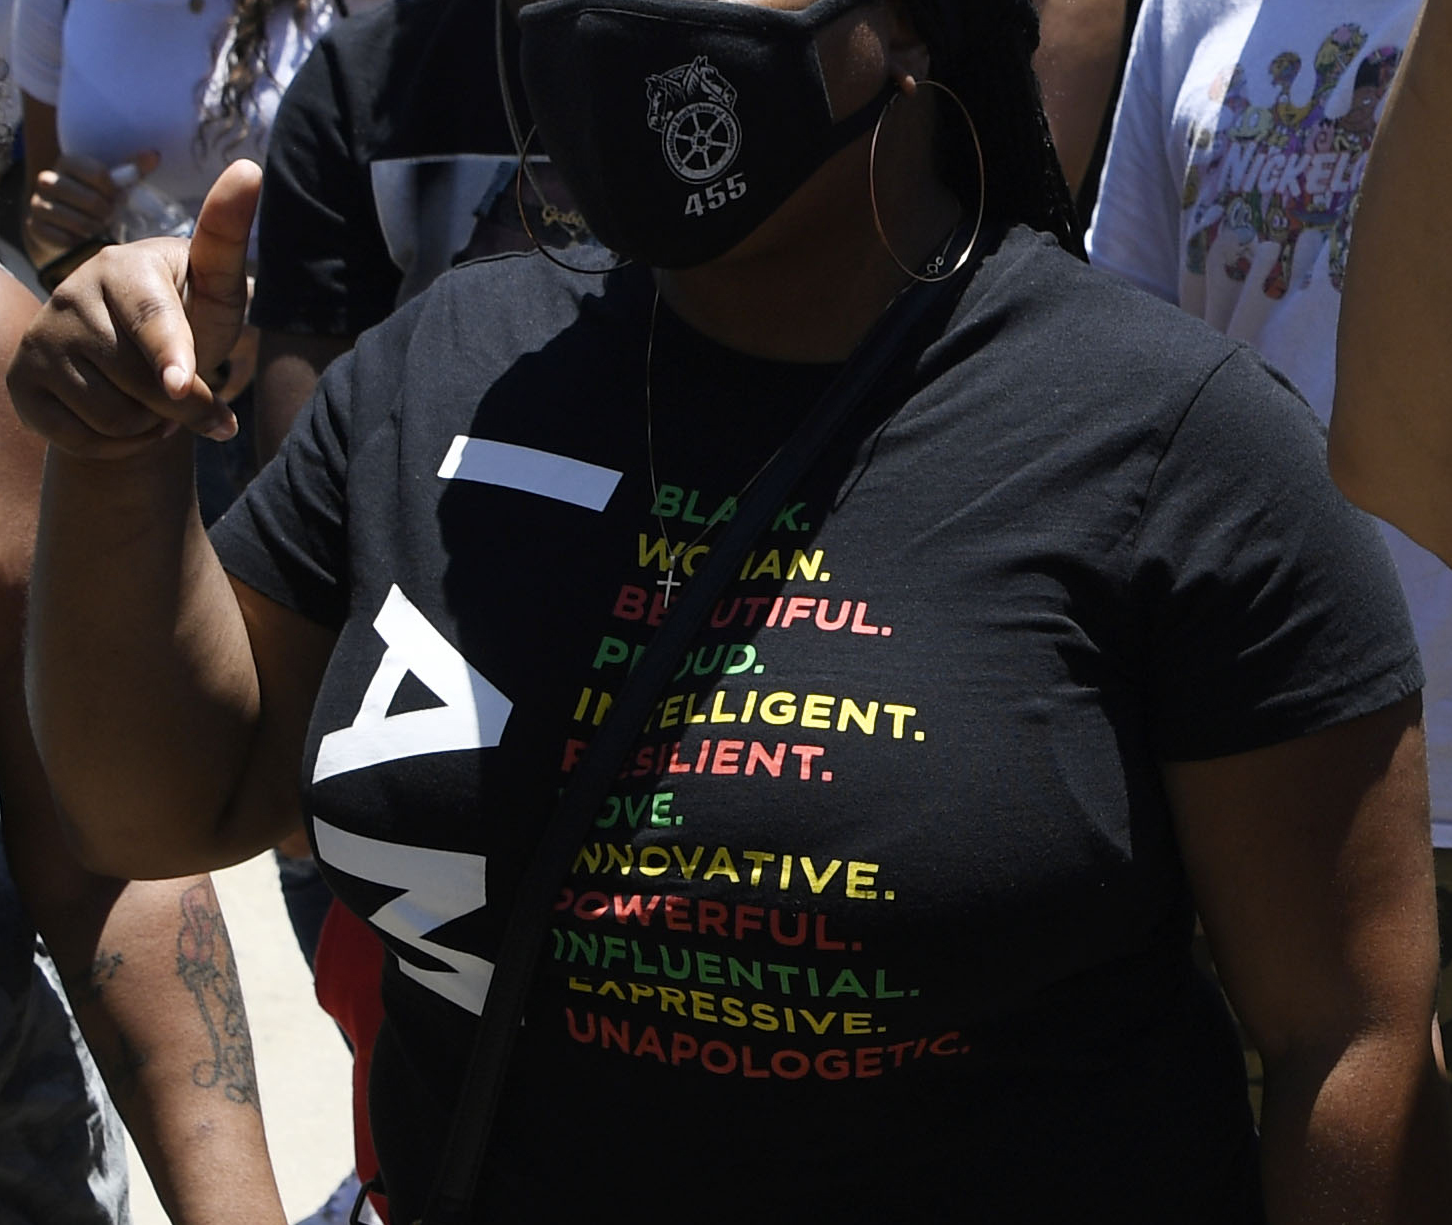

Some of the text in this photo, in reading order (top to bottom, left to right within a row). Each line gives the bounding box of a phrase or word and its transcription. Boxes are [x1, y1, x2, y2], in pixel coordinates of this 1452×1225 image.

[684, 173, 748, 218] 455
[651, 484, 811, 532] BLAK.
[637, 532, 832, 582] WOAN.
[612, 583, 894, 638] BEUTIFUL.
[592, 635, 767, 682] PUD.
[573, 687, 926, 742] INELLIGENT.
[561, 738, 834, 782] RSILIENT.
[562, 787, 684, 830] OVE.
[572, 842, 896, 901] NNOVATIVE.
[551, 928, 921, 999] INFLUENTIAL.
[568, 975, 888, 1035] EXPRESSIVE.
[566, 1006, 972, 1080] UNAPOLOGETIC.
